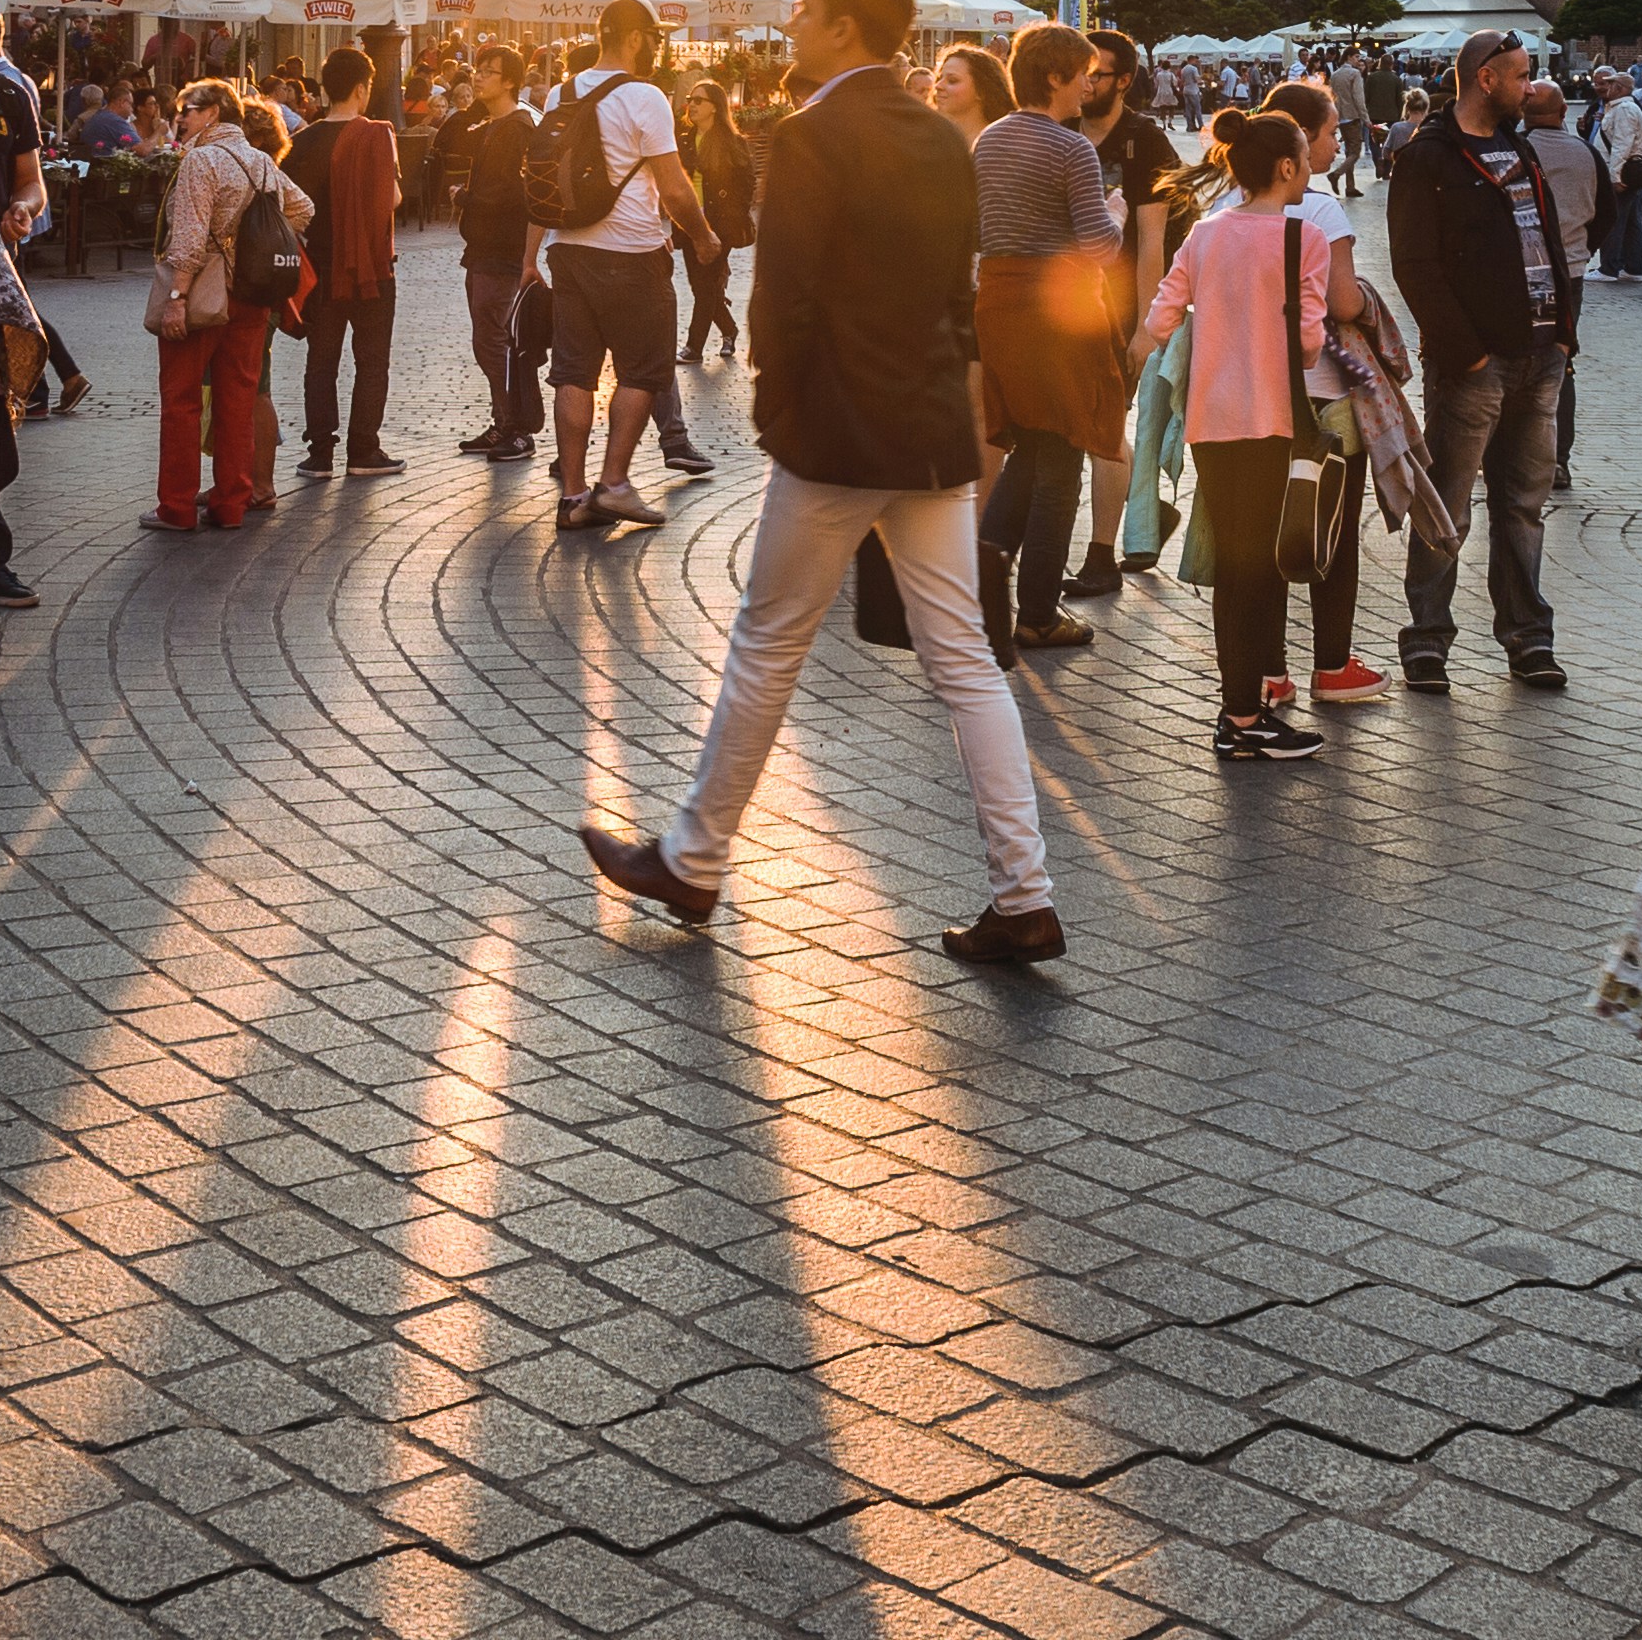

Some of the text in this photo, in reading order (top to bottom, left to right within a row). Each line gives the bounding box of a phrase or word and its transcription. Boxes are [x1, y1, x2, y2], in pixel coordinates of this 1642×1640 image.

[310, 0, 350, 15] ŻYWIEC
[539, 2, 583, 17] MAX
[740, 1, 753, 15] 18
